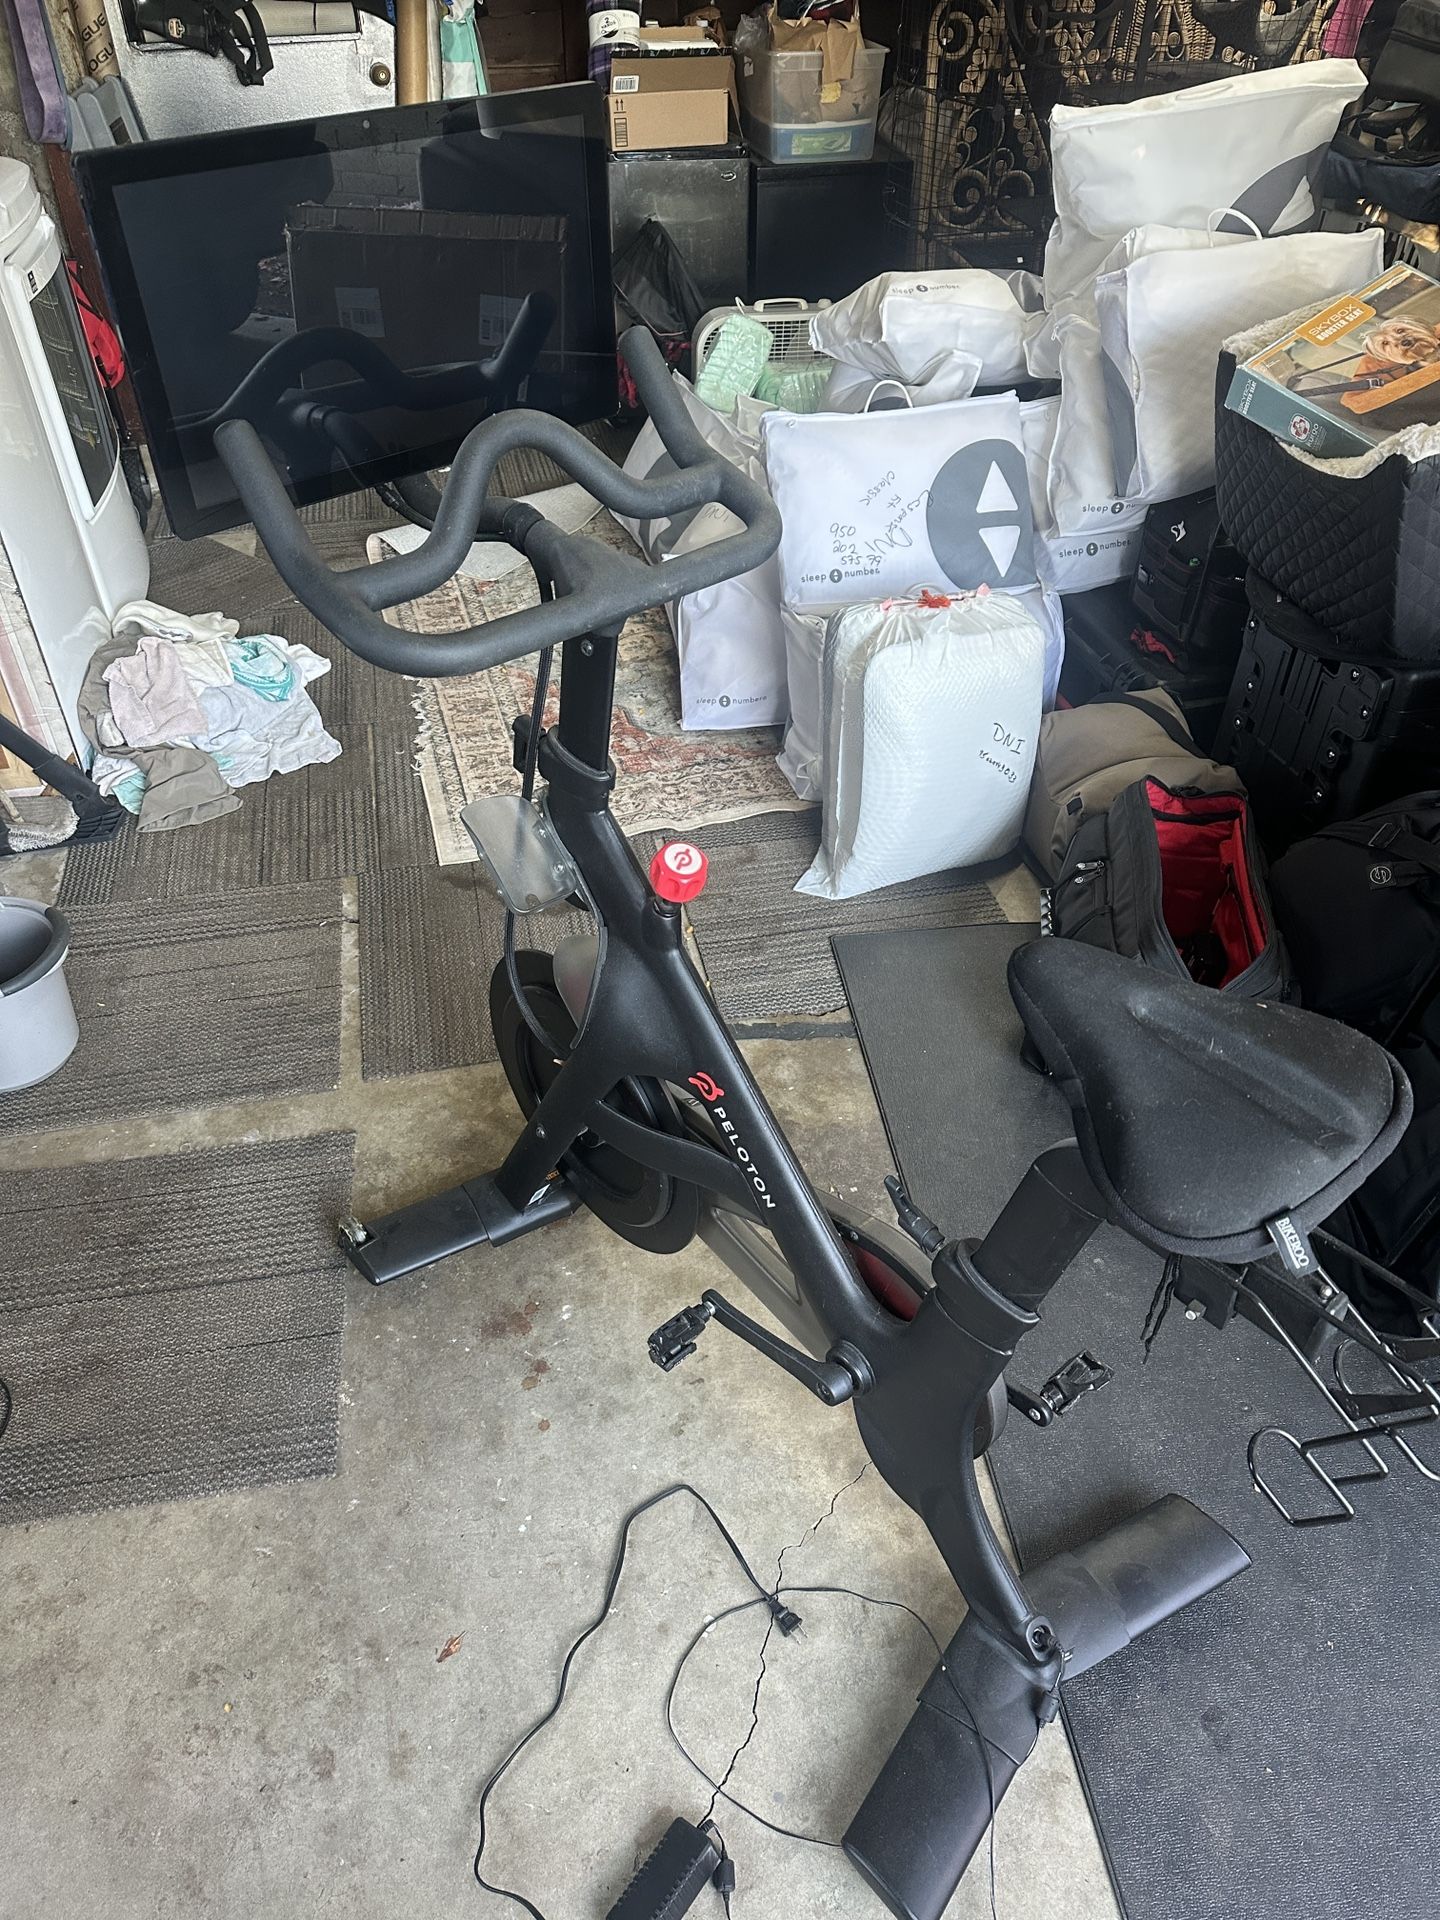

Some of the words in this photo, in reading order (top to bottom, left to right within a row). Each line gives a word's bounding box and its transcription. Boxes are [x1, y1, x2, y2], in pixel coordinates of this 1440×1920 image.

[81, 13, 107, 41] GUE
[88, 42, 114, 72] OGU
[1308, 303, 1358, 336] SKYBOX
[1316, 319, 1349, 341] BOOSTER
[1082, 503, 1109, 514] sleep
[1059, 547, 1084, 558] sleep
[1100, 539, 1131, 550] number
[801, 573, 827, 583] sleep
[844, 567, 880, 578] number
[696, 697, 717, 706] sleep
[993, 722, 1026, 755] DNI
[714, 1106, 776, 1208] PELOTON
[1278, 1217, 1310, 1267] BIKEROO
